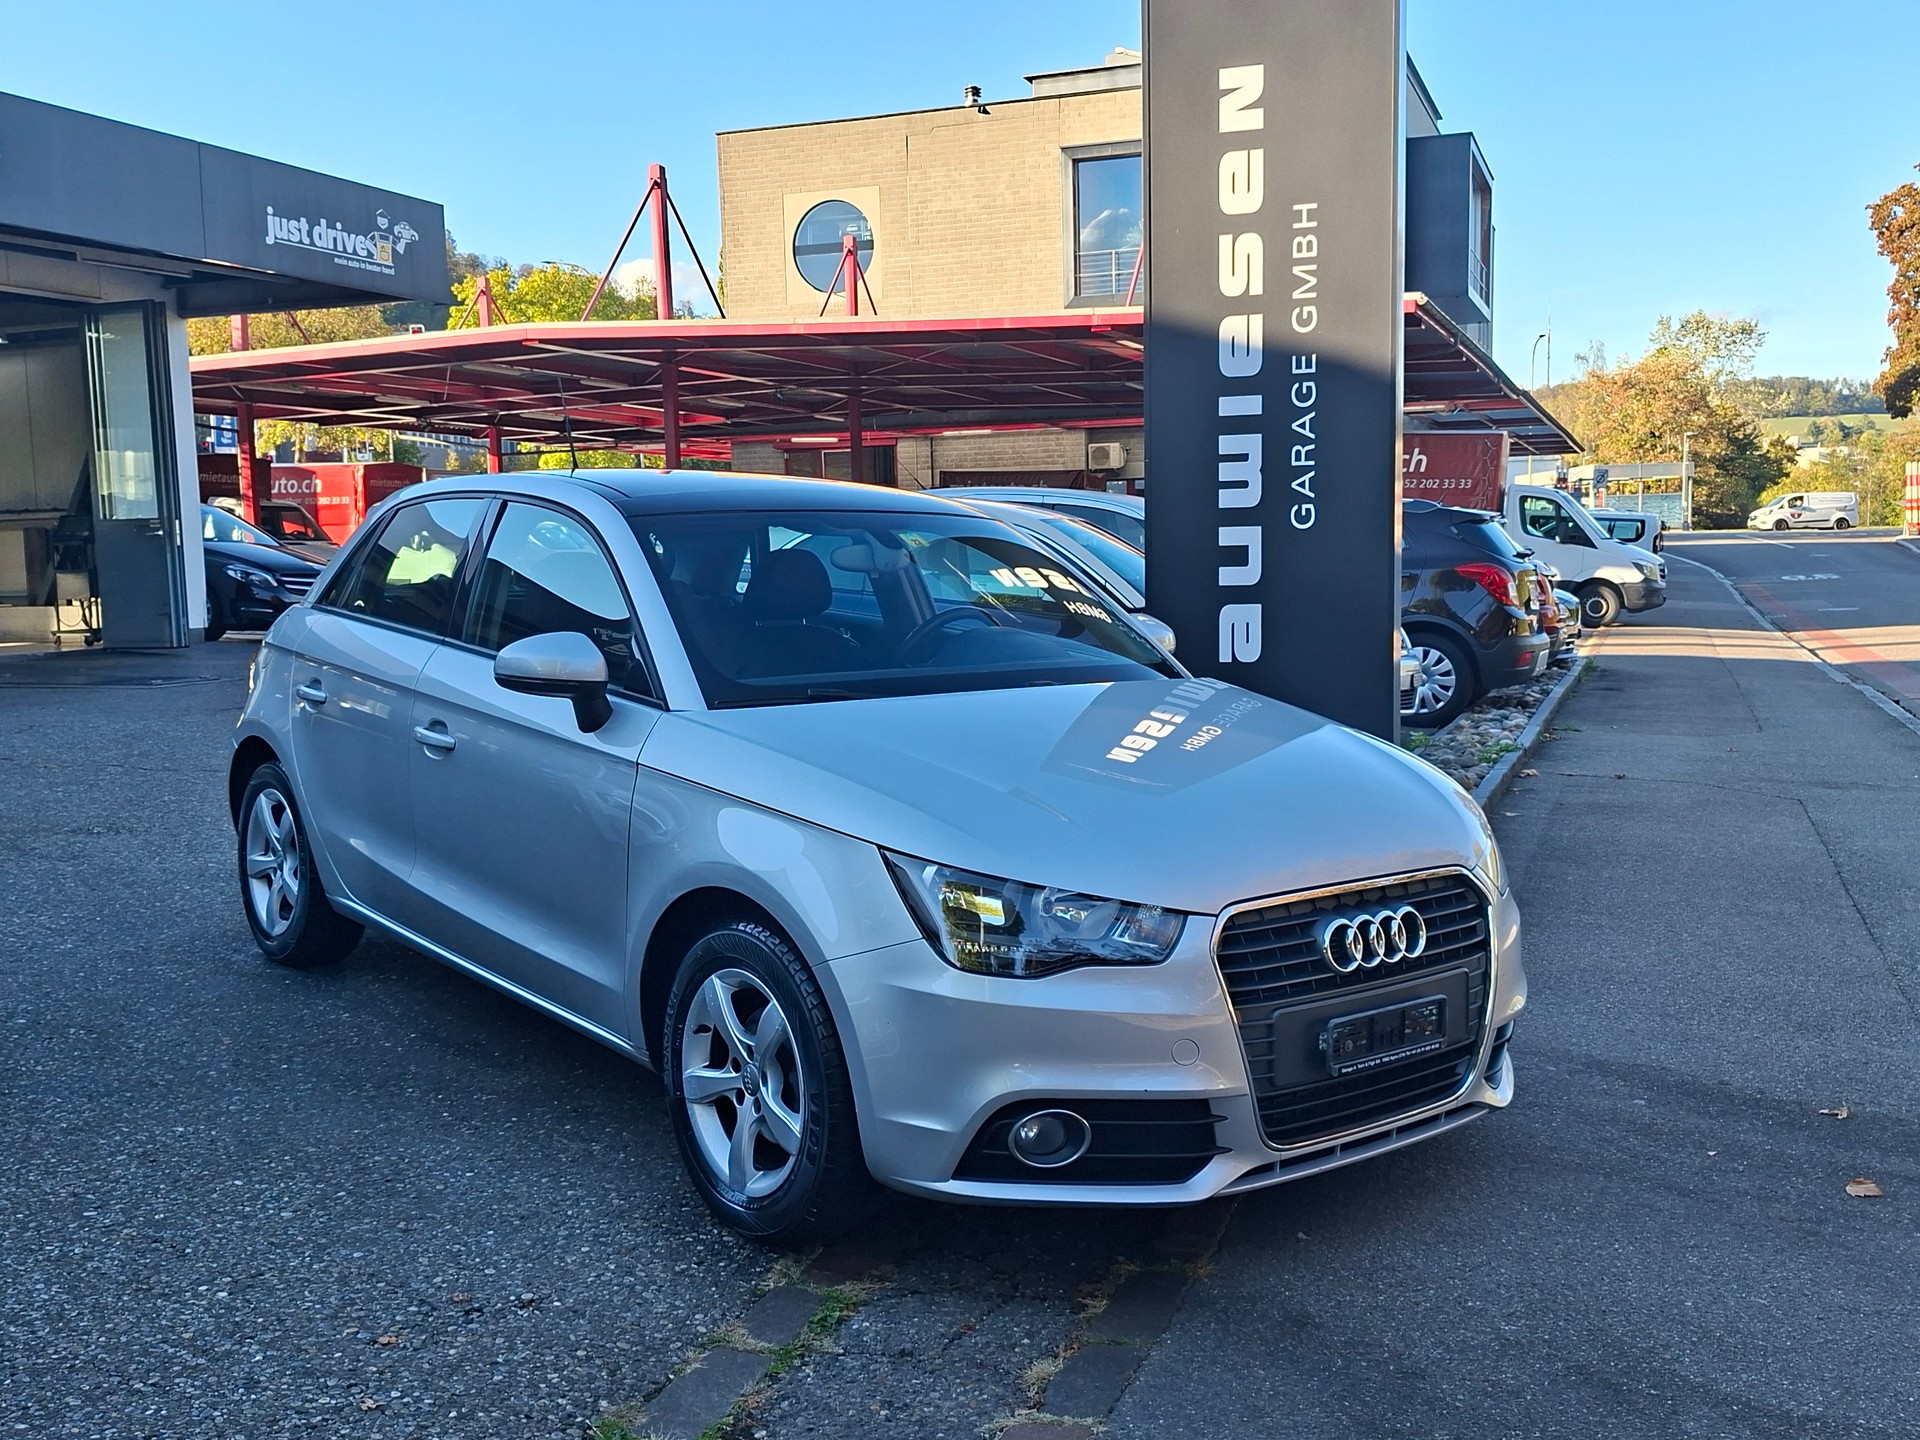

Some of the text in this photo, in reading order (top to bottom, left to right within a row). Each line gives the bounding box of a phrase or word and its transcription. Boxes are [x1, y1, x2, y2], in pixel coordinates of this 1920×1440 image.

[265, 206, 368, 257] just drive
[1290, 202, 1319, 530] GARAGE GMBH
[200, 472, 240, 483] mietaut
[1419, 479, 1440, 488] 202
[1442, 479, 1456, 488] 33
[1458, 479, 1472, 488] 33
[318, 496, 331, 504] 202
[331, 496, 341, 504] 33
[341, 496, 350, 504] 33
